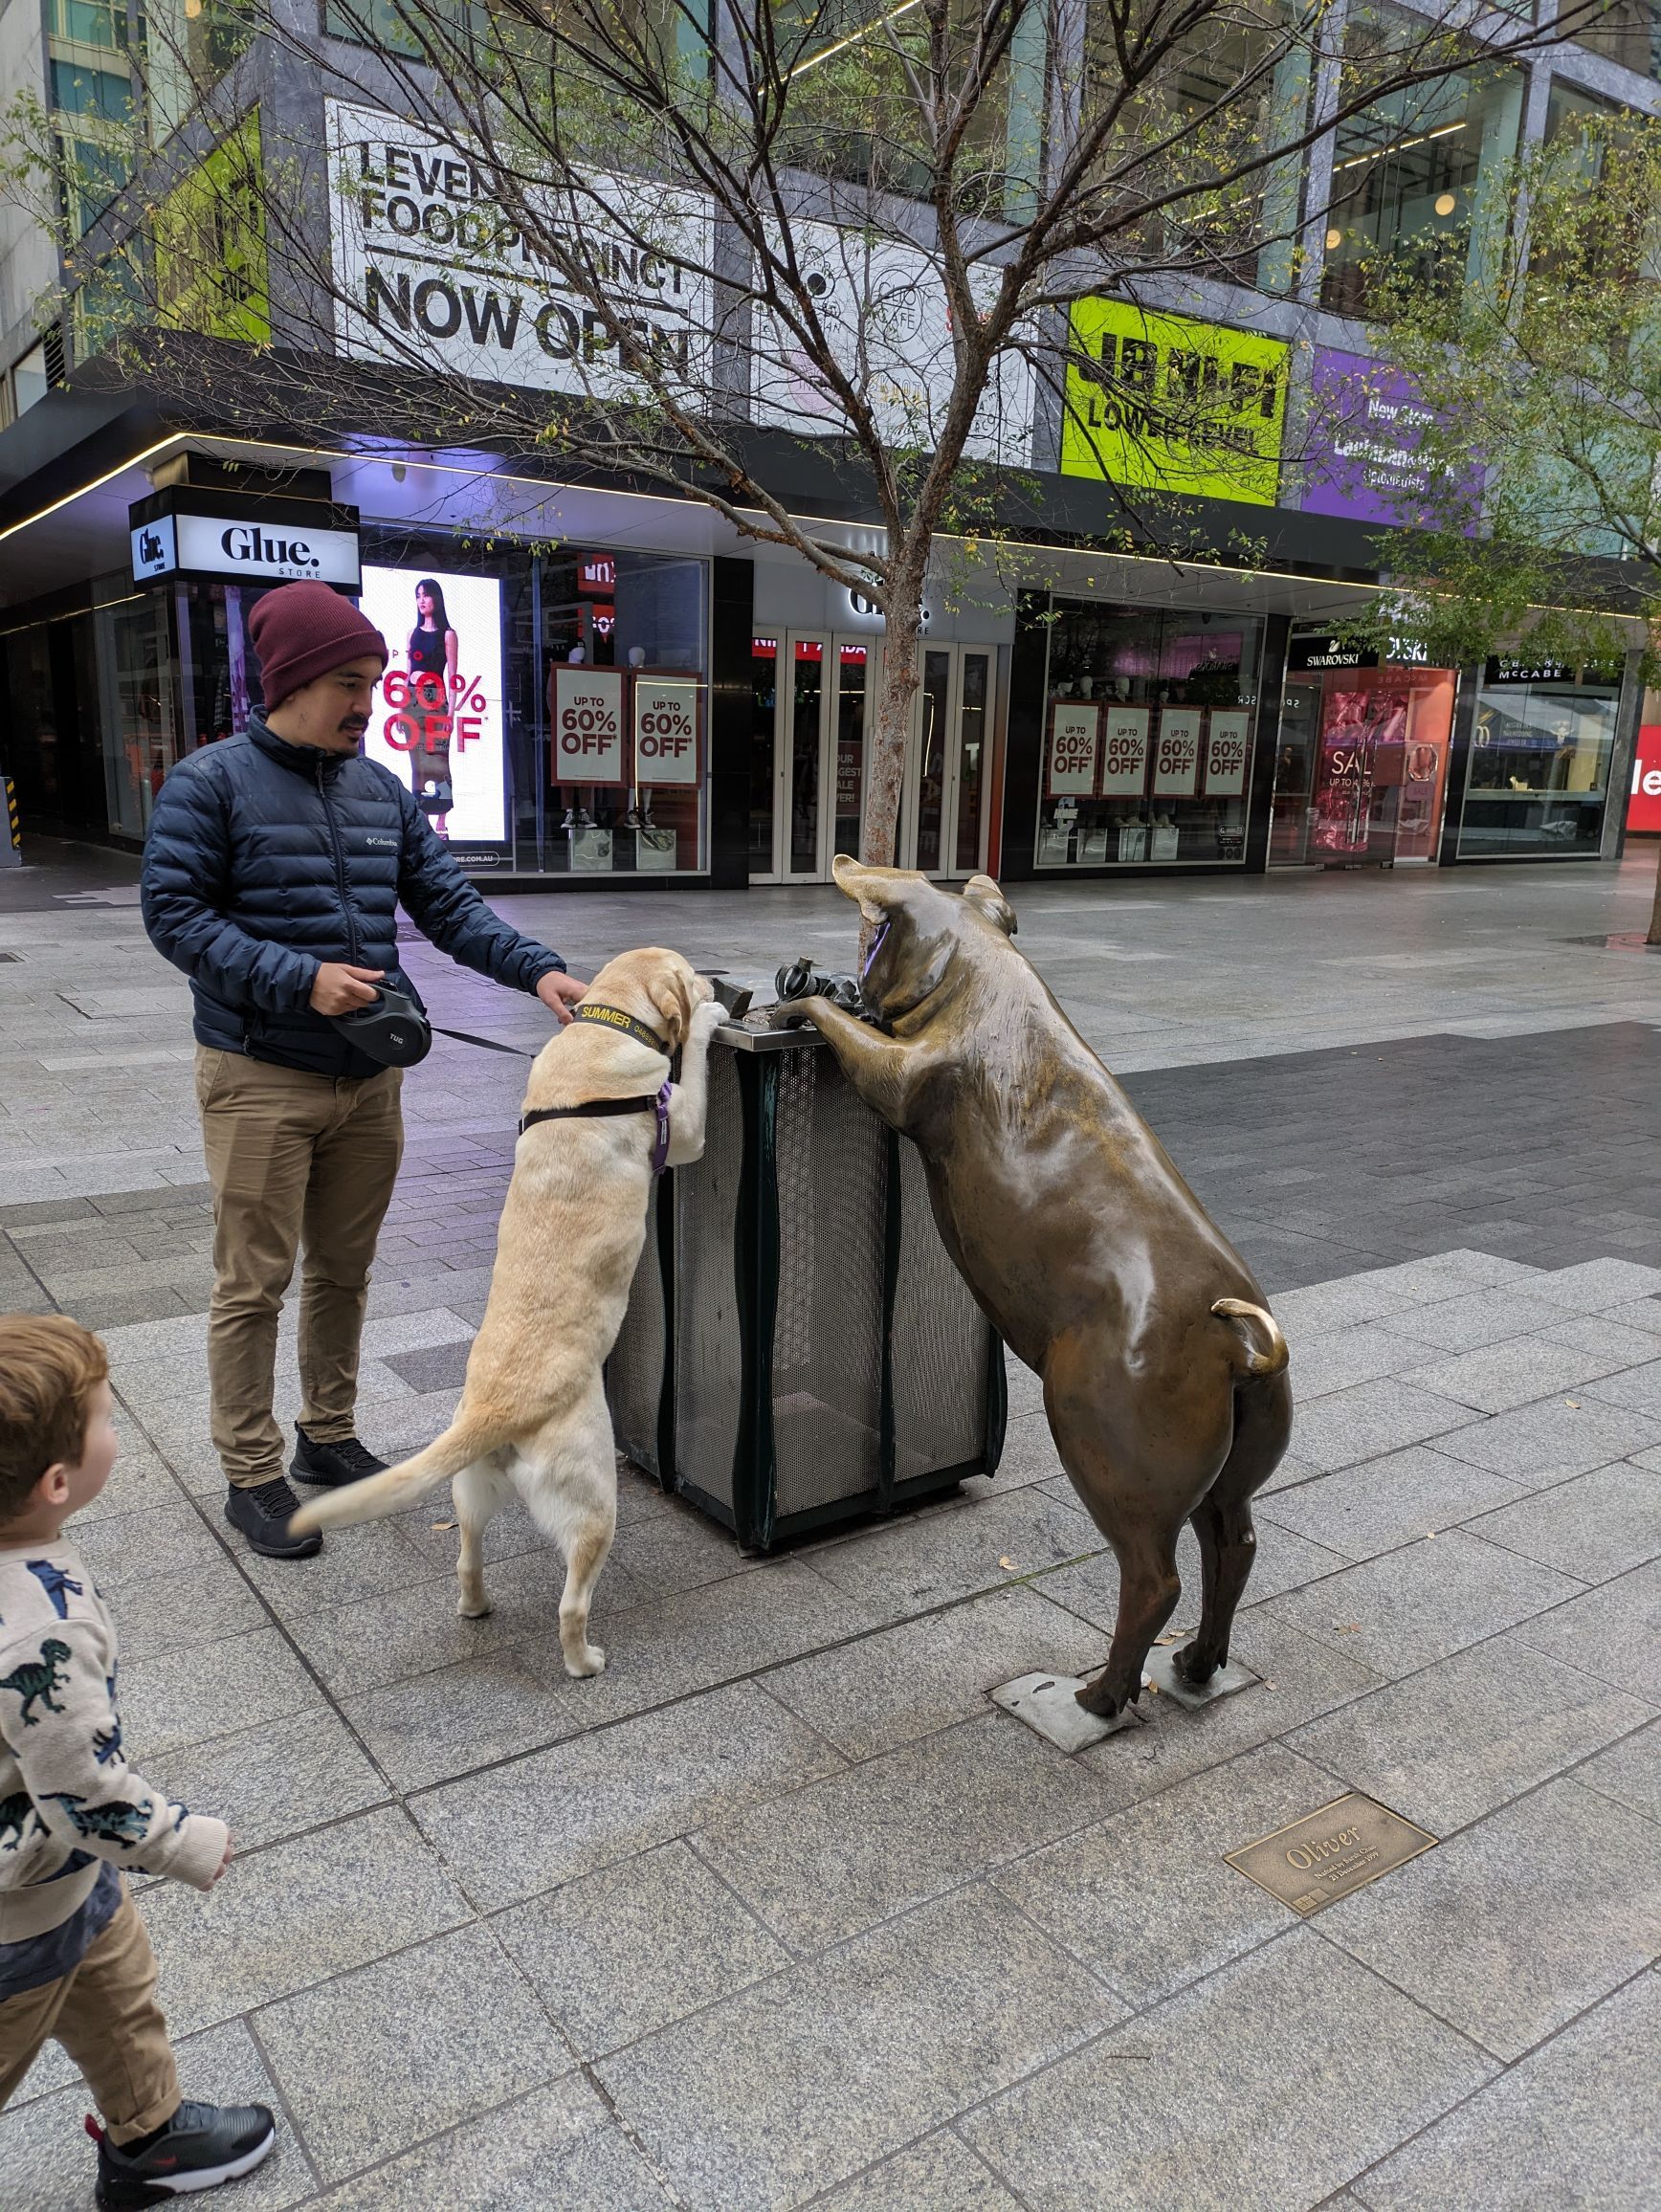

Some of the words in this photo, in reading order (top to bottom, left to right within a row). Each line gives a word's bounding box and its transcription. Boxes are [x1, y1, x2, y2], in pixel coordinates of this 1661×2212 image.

[363, 189, 491, 253] FOOD
[365, 266, 523, 350] NOW
[536, 302, 688, 383] OPEN
[1078, 332, 1158, 387] JB
[1368, 396, 1399, 421] New
[139, 528, 164, 564] Glue.
[221, 527, 321, 567] Glue.
[279, 567, 321, 579] STORE
[1307, 653, 1360, 667] SWAROVSKI
[1499, 670, 1561, 678] McCABE
[384, 670, 486, 713] 60%
[574, 697, 587, 706] UP
[590, 697, 604, 707] TO
[653, 700, 666, 711] UP
[667, 702, 681, 712] TO
[562, 708, 617, 733] 60%
[641, 713, 692, 736] 60%
[1055, 736, 1093, 754] 60%
[1109, 739, 1143, 756] 60%
[1161, 739, 1194, 756] 60%
[1211, 741, 1243, 758] 60%
[1331, 751, 1372, 775] SAL
[838, 767, 861, 778] GGEST
[837, 780, 854, 790] ALE
[1329, 778, 1340, 786] UP
[1341, 778, 1352, 786] TO
[836, 793, 855, 804] VER!
[582, 1006, 631, 1029] SUMMER
[389, 1032, 403, 1044] TUG
[1286, 1826, 1361, 1869] Oliver
[1314, 1864, 1337, 1880] Named
[1337, 1859, 1365, 1877] December
[1364, 1851, 1379, 1862] 1999
